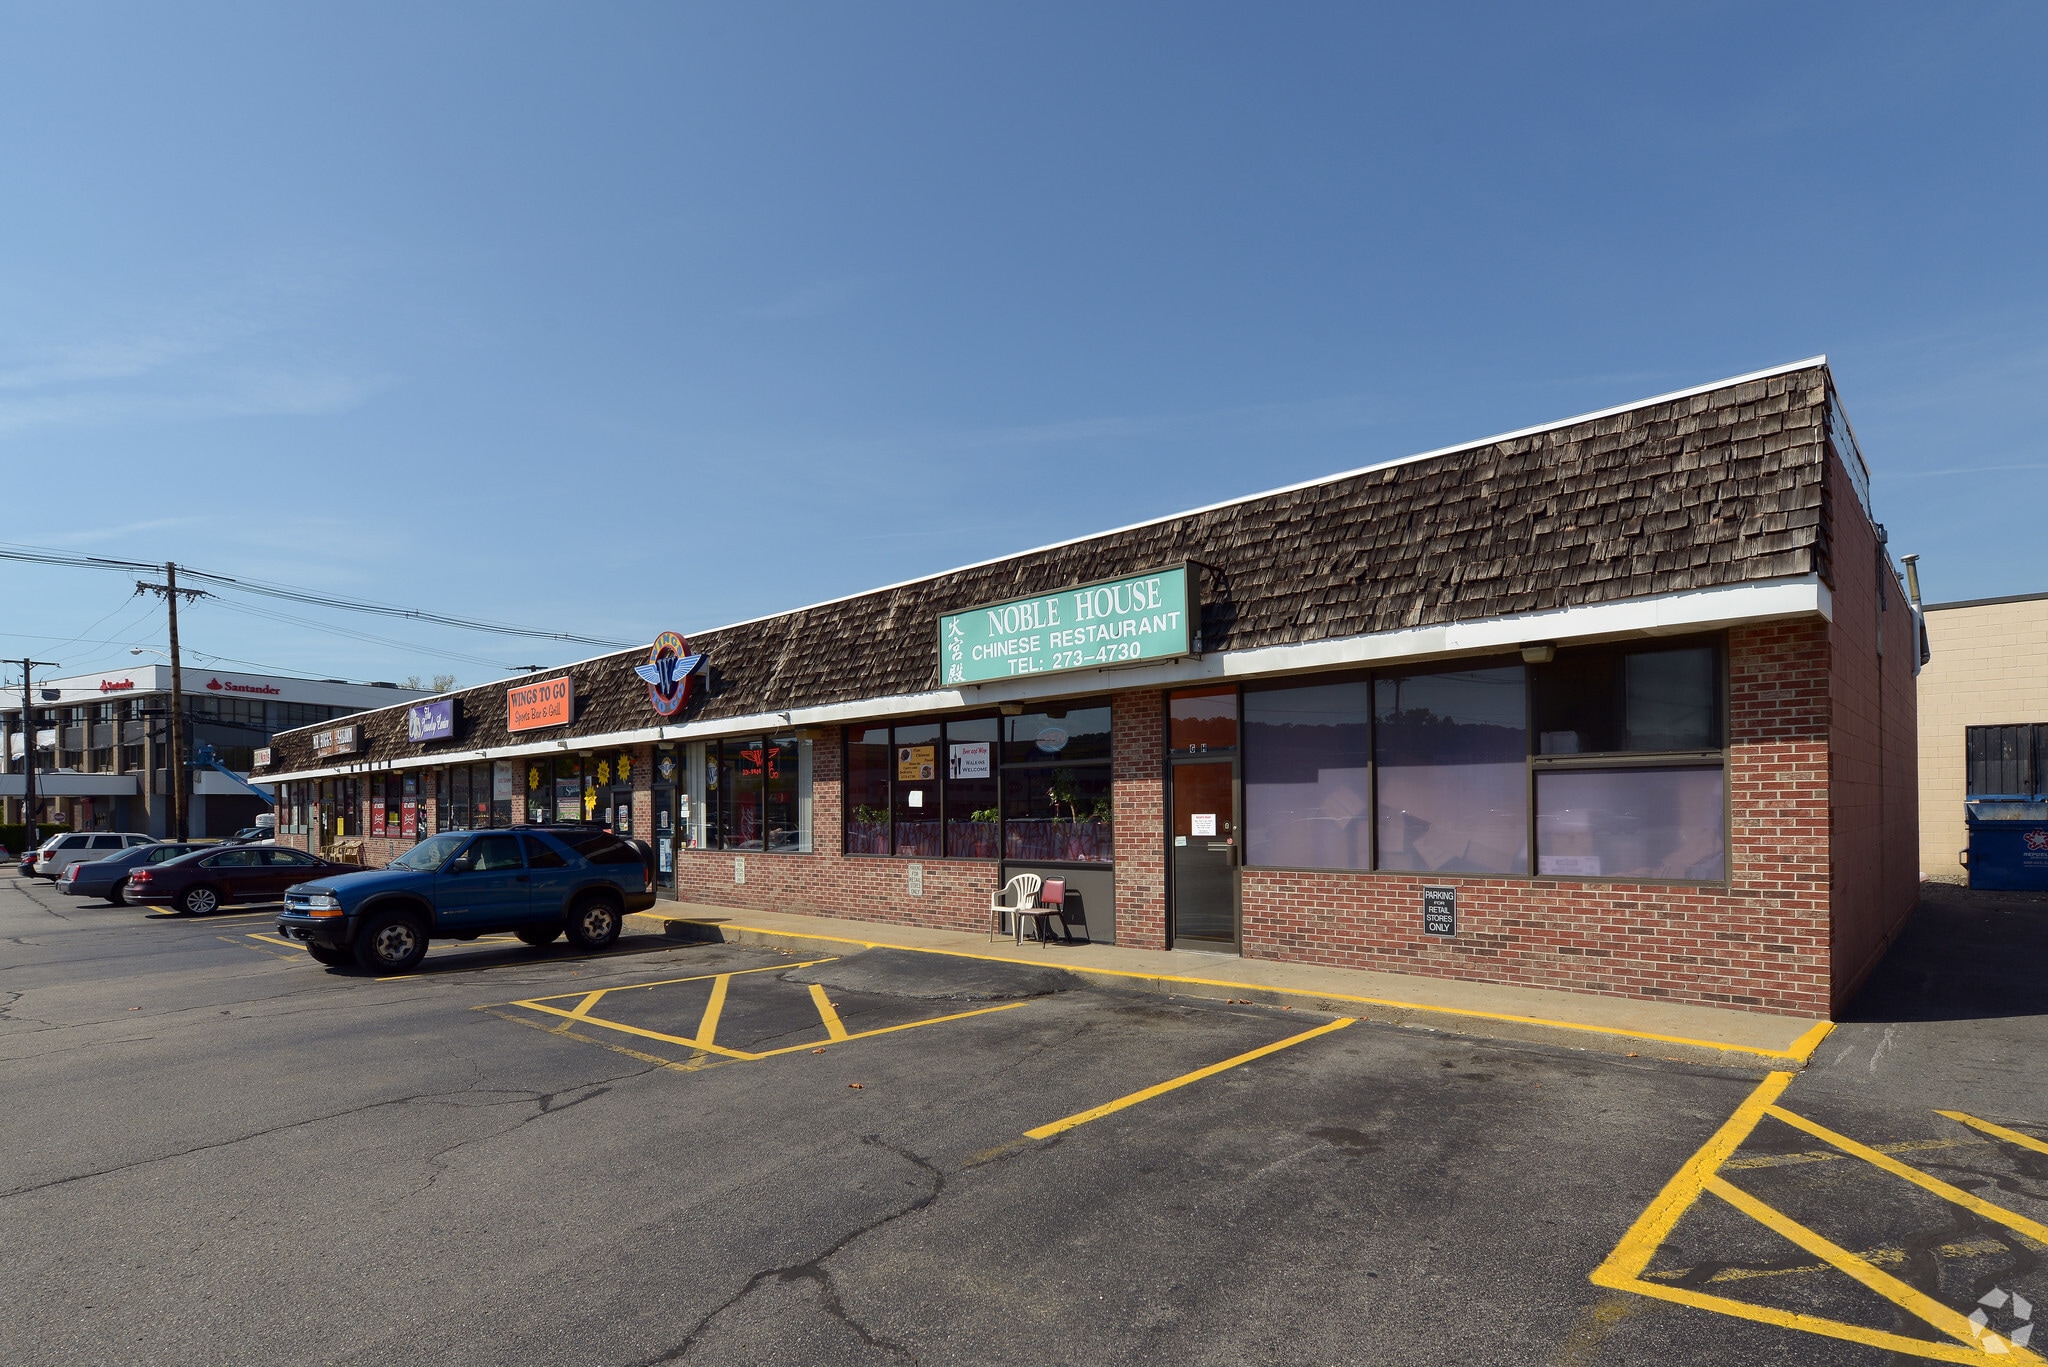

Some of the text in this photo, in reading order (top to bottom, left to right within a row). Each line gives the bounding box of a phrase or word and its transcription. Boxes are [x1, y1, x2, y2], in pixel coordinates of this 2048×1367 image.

[987, 578, 1162, 637] NOBLE HOUSE
[972, 611, 1181, 661] CHINESE RESTAURANT
[1007, 641, 1141, 675] TEL: 273-4730
[224, 681, 281, 695] Santander
[511, 682, 566, 707] WINGS TO GO
[515, 702, 561, 725] Sports Bar & Grill
[1425, 890, 1454, 900] PARKING
[1426, 914, 1453, 923] STORES
[1428, 906, 1450, 914] RETAIL
[1429, 922, 1450, 932] ONLY
